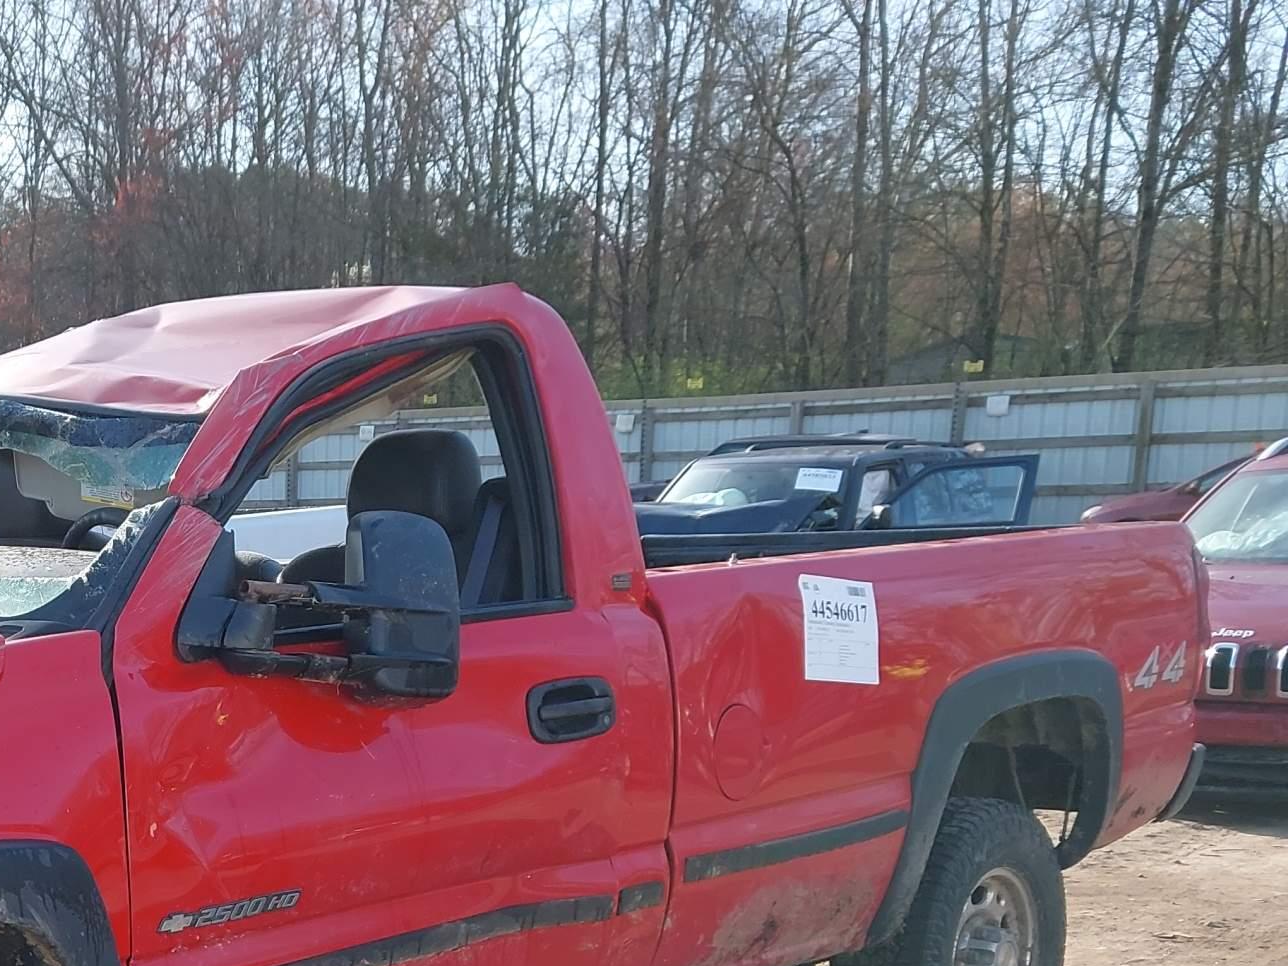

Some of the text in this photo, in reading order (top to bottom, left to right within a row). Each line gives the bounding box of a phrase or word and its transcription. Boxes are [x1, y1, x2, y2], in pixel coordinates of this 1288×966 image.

[811, 599, 867, 623] 44546617
[1211, 627, 1255, 639] Jeep
[195, 893, 300, 927] 2500 HD
